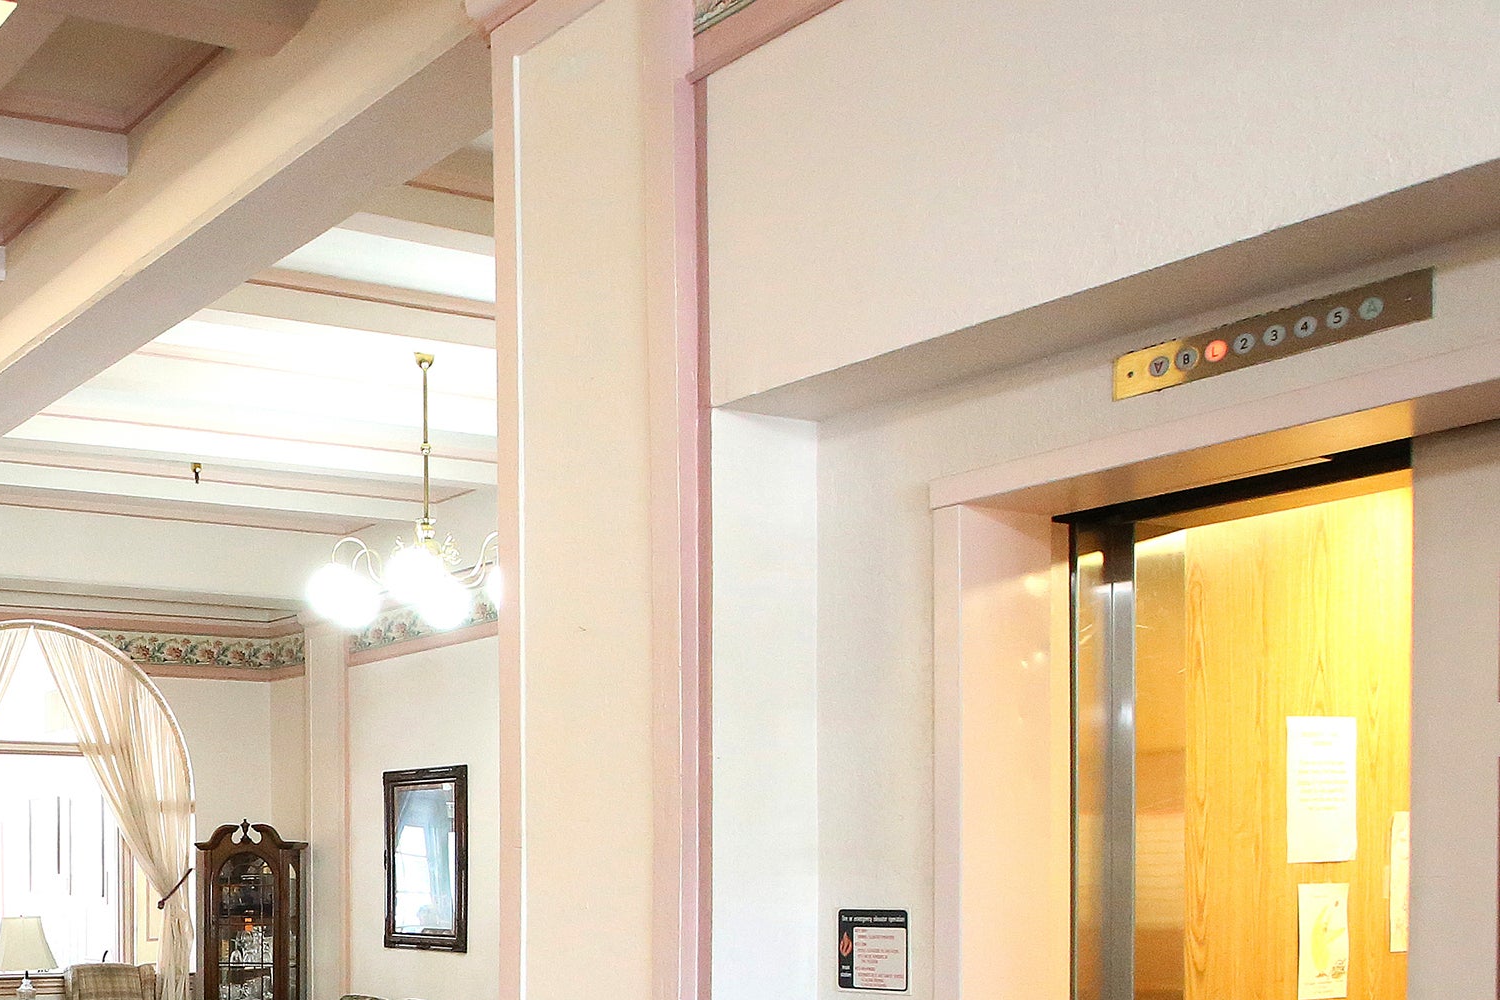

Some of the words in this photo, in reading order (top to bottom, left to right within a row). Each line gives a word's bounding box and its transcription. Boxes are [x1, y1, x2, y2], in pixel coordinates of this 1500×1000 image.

[1211, 346, 1219, 357] L
[1240, 338, 1248, 350] 2
[1270, 330, 1278, 341] 3
[1301, 322, 1308, 332] 4
[1333, 312, 1342, 324] 5
